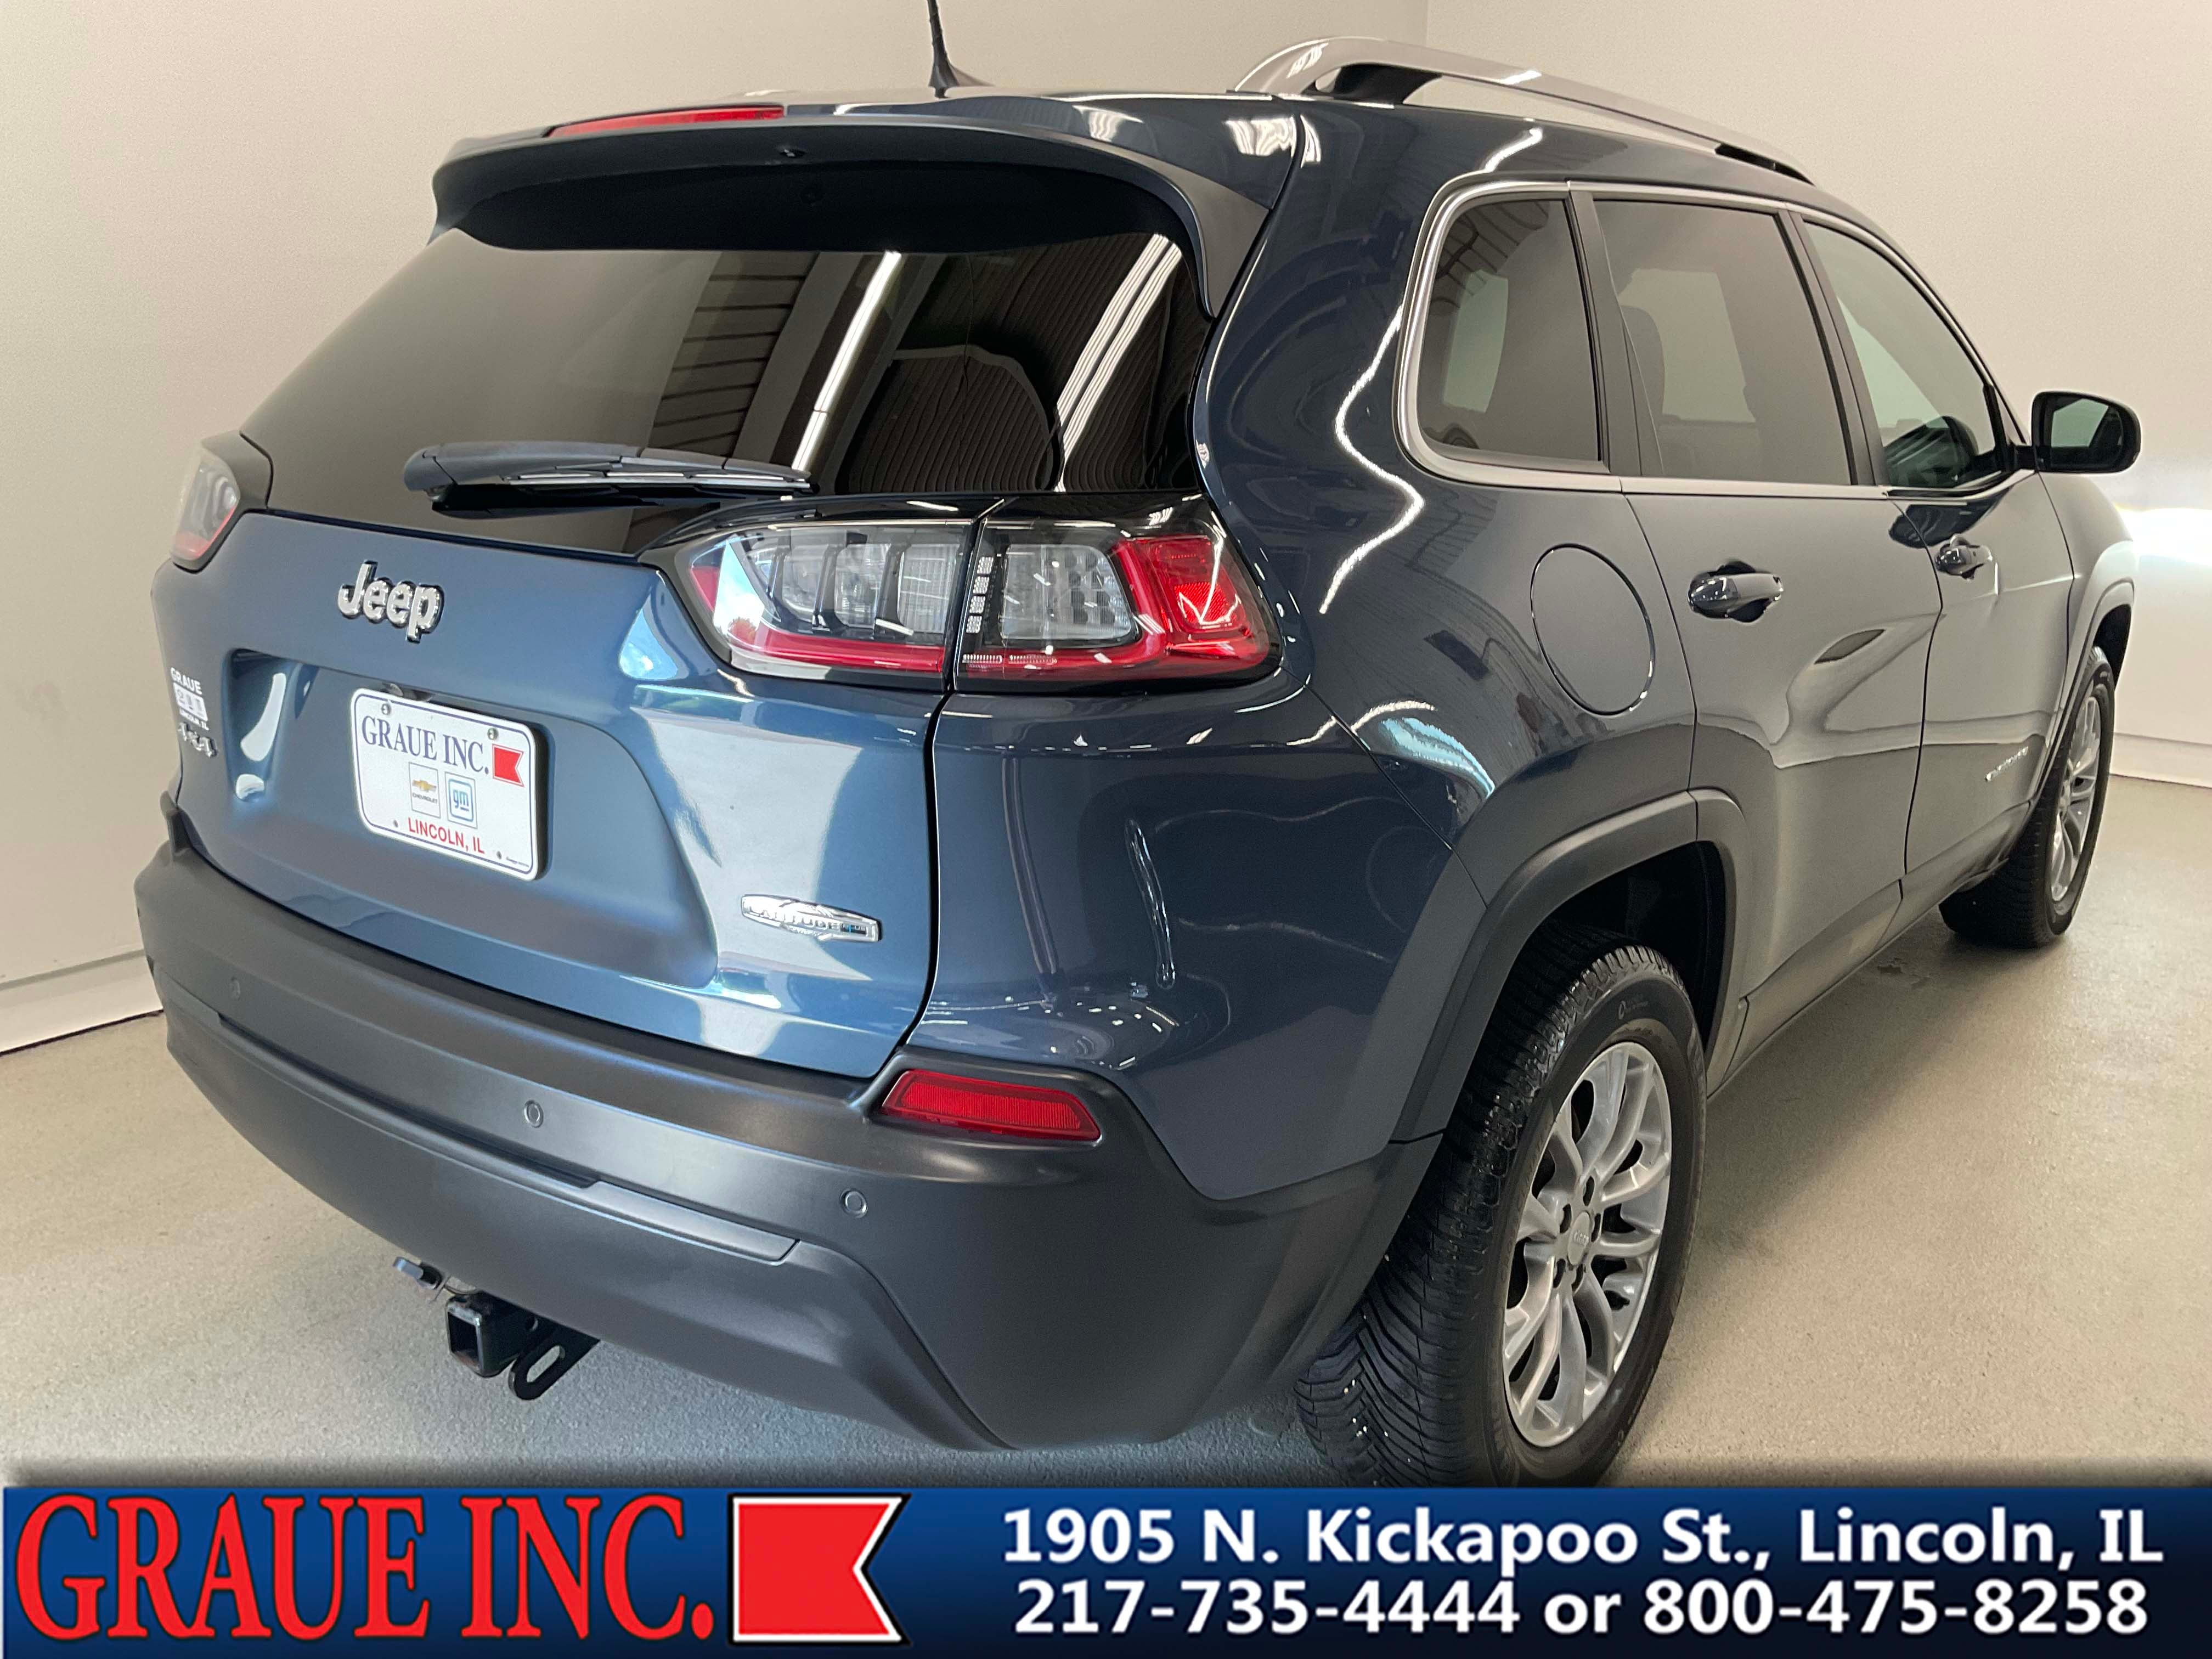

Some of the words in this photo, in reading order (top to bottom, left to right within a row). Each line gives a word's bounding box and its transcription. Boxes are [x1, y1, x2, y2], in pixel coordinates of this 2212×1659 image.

[337, 560, 444, 644] Jeep
[170, 667, 202, 695] GRAUE
[361, 715, 438, 760] GRAUE
[442, 733, 489, 775] INC.
[412, 792, 438, 804] CHEVROLET
[453, 789, 470, 811] gm
[408, 817, 469, 852] LINCOLN,
[472, 836, 485, 854] IL
